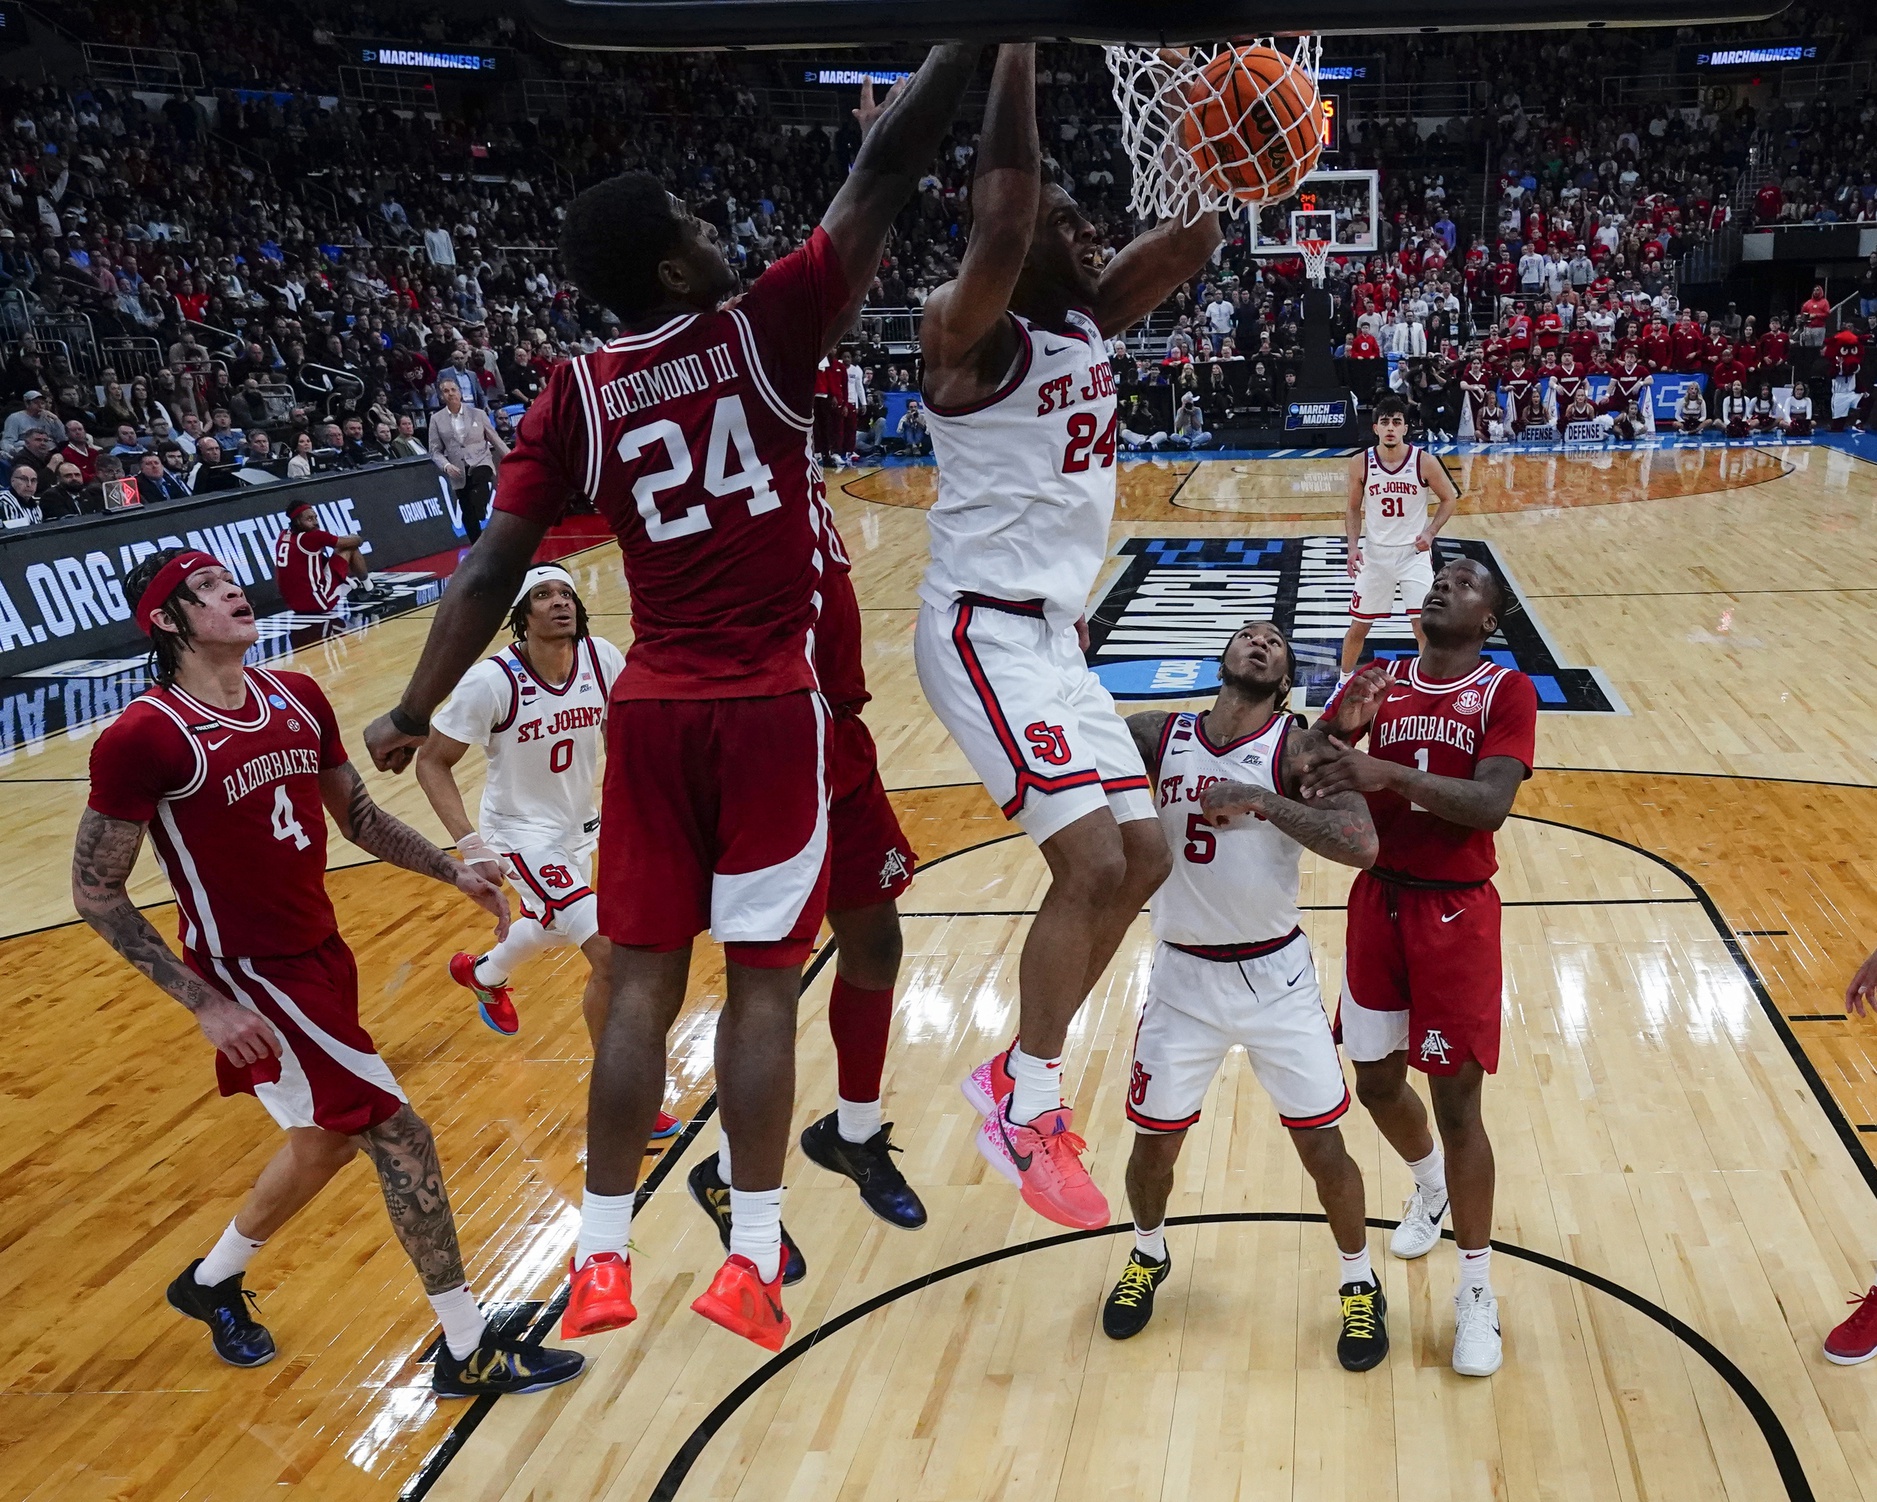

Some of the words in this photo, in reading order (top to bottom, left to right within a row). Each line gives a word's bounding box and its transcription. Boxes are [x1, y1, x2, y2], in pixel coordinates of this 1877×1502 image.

[379, 49, 480, 70] MARCHMADNESS
[1711, 47, 1802, 65] MARCHMADNESS
[1303, 67, 1353, 80] DNESS
[600, 354, 709, 421] RICHMOND
[706, 343, 738, 383] III
[1037, 373, 1075, 417] ST.
[1299, 405, 1330, 414] MARCH
[1303, 414, 1344, 424] MADNESS
[1062, 409, 1117, 473] 24
[1521, 426, 1553, 440] DEFENSE
[1568, 424, 1600, 440] DEFENSE
[617, 394, 782, 542] 24
[1369, 484, 1381, 496] ST.
[1382, 482, 1418, 495] JOHN'S
[399, 499, 427, 523] DRAW
[424, 497, 443, 517] THE
[1381, 497, 1405, 517] 31
[1459, 691, 1478, 707] SEC
[517, 717, 545, 743] ST.
[547, 706, 602, 735] JOHN'S
[1380, 715, 1475, 755] RAZORBACKS
[550, 739, 574, 773] 0
[223, 749, 319, 806] RAZORBACKS
[1161, 775, 1185, 808] ST.
[271, 784, 311, 851] 4
[1184, 813, 1216, 864] 5
